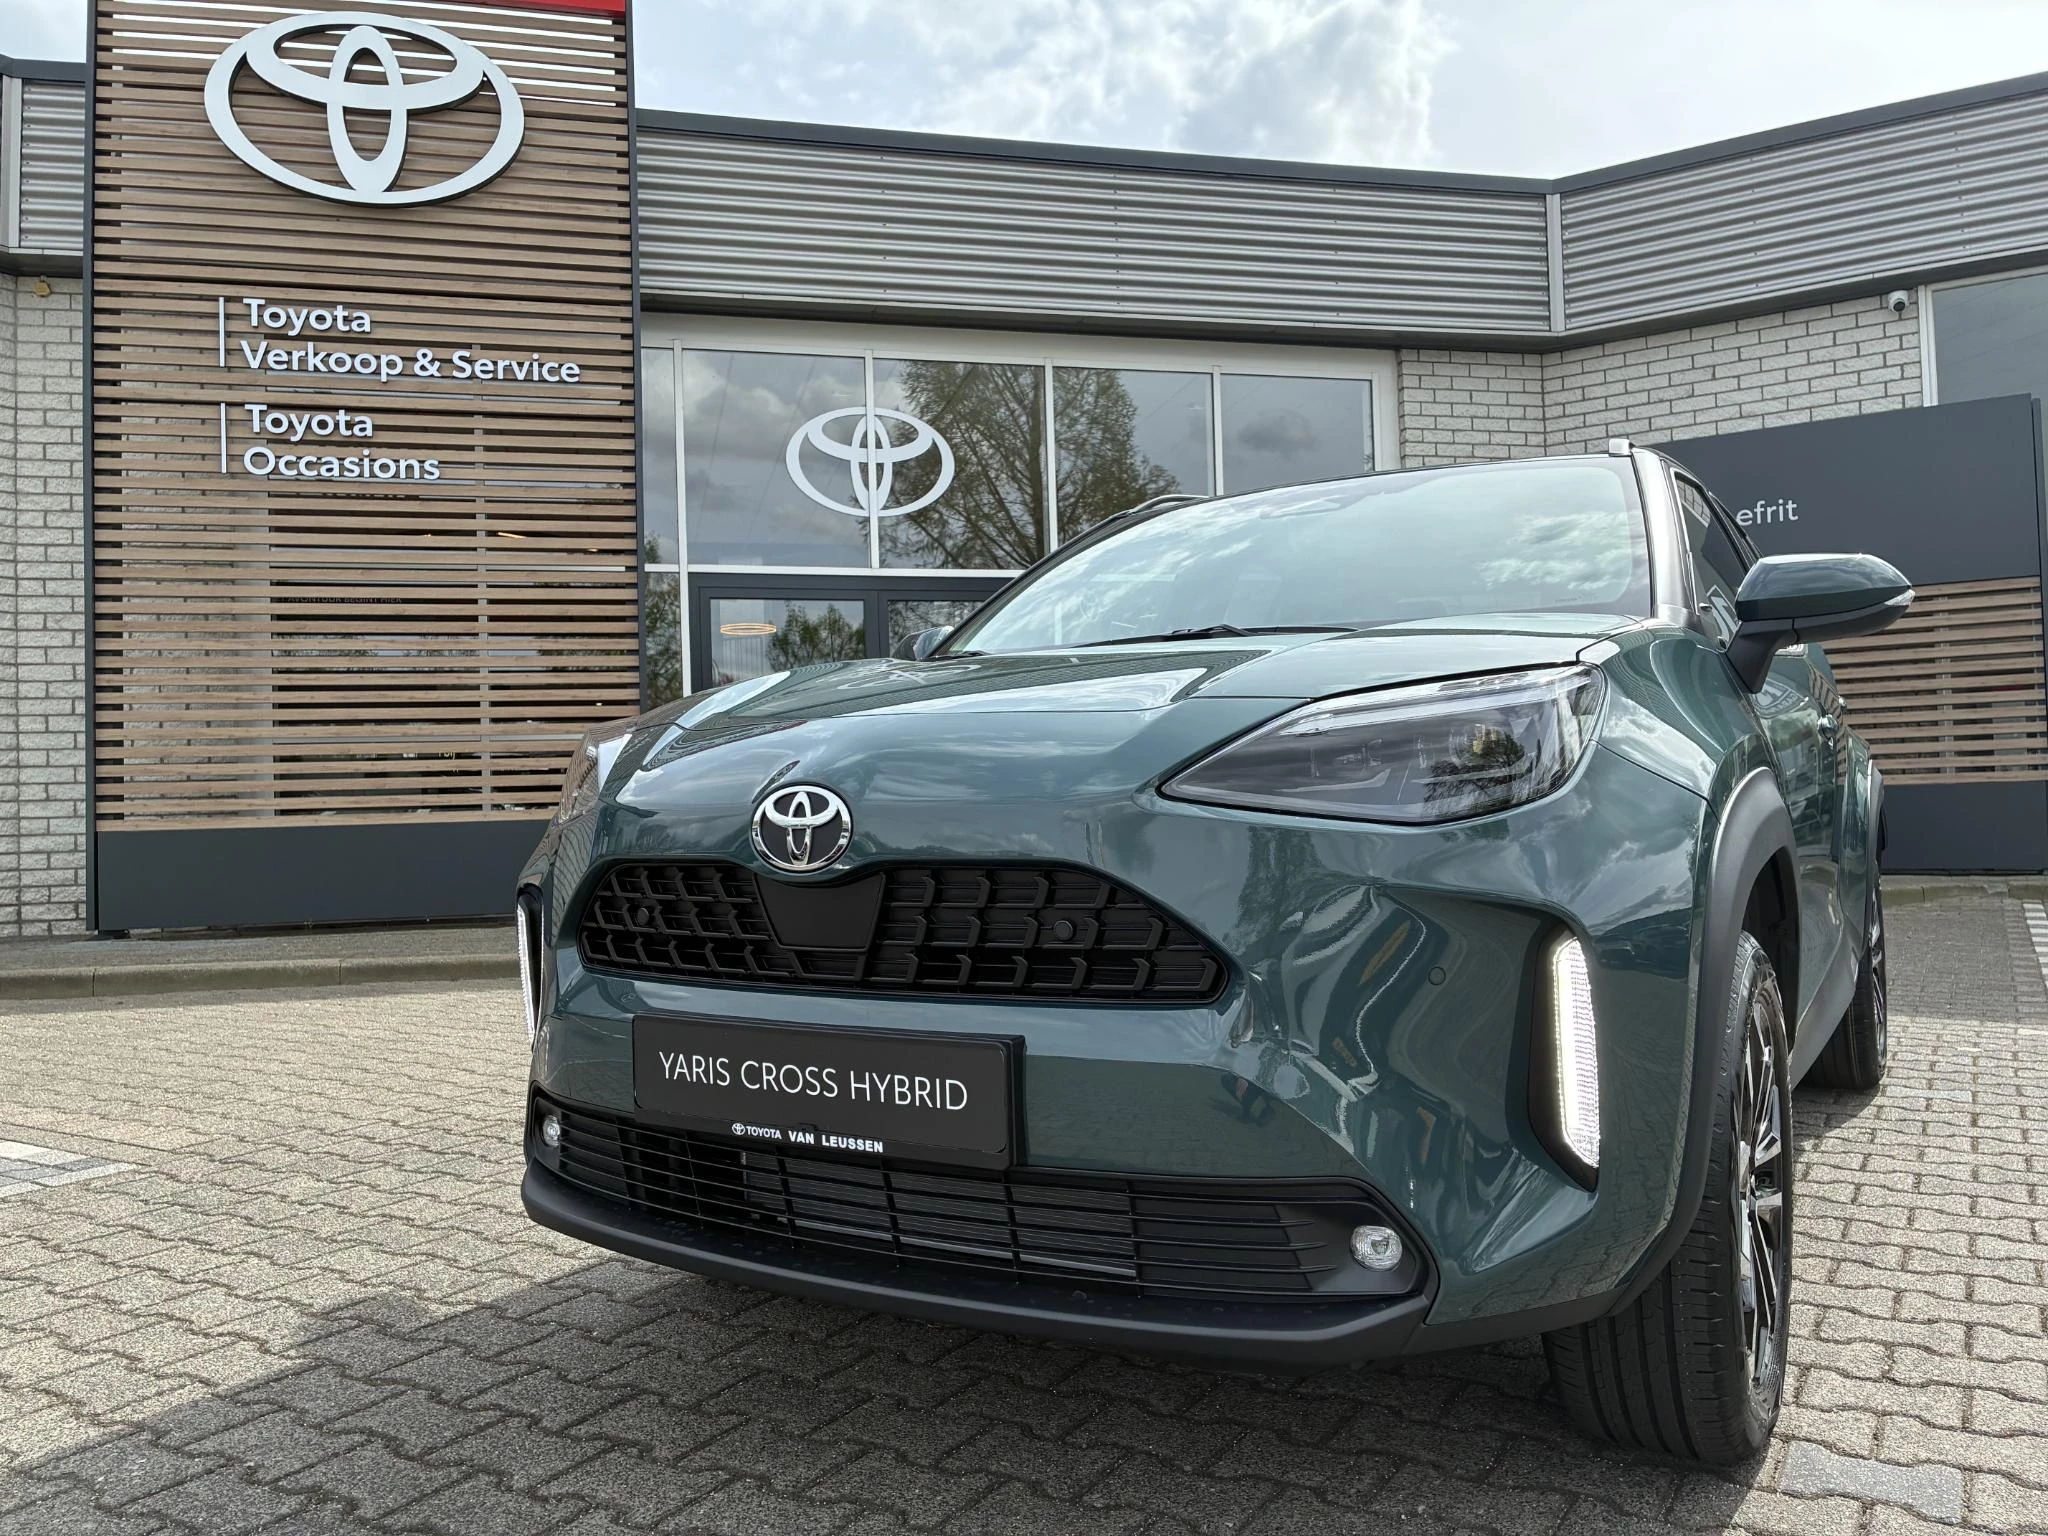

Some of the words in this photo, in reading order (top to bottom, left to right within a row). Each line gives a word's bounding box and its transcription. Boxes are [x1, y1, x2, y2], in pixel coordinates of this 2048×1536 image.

[243, 298, 371, 336] Toyota
[240, 340, 403, 382] Verkoop
[413, 348, 441, 377] &
[452, 350, 581, 382] Service
[244, 404, 373, 441] Toyota
[243, 446, 440, 480] Occasions
[658, 1051, 731, 1086] YARIS
[740, 1060, 839, 1098] CROSS
[850, 1070, 968, 1110] HYBRID
[746, 1125, 782, 1140] TOYOTA
[788, 1130, 815, 1145] VAN
[821, 1134, 884, 1154] LEUSSEN
